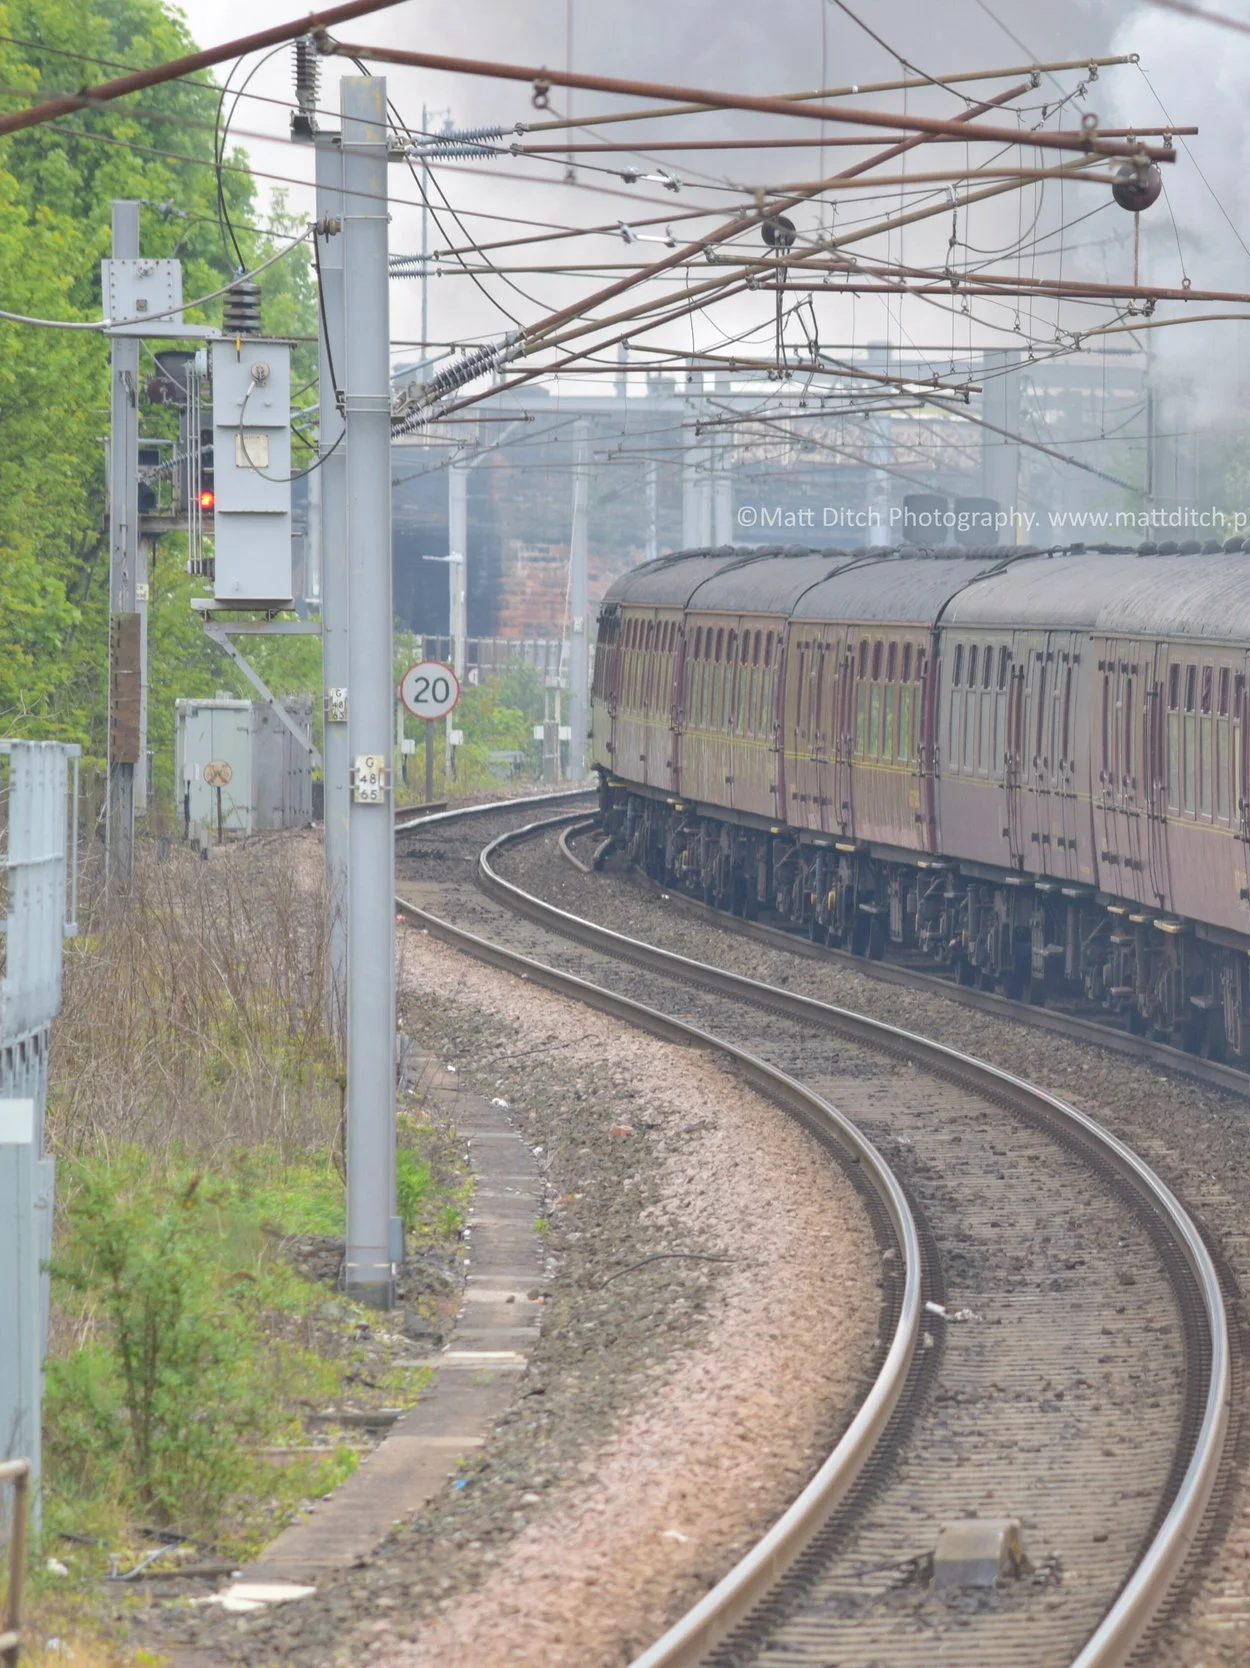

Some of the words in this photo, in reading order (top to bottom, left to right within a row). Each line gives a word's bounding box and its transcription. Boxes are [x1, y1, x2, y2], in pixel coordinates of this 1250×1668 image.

[335, 689, 342, 697] G
[414, 676, 450, 704] 20
[365, 757, 374, 768] G
[359, 773, 377, 785] 48
[360, 789, 378, 800] 65
